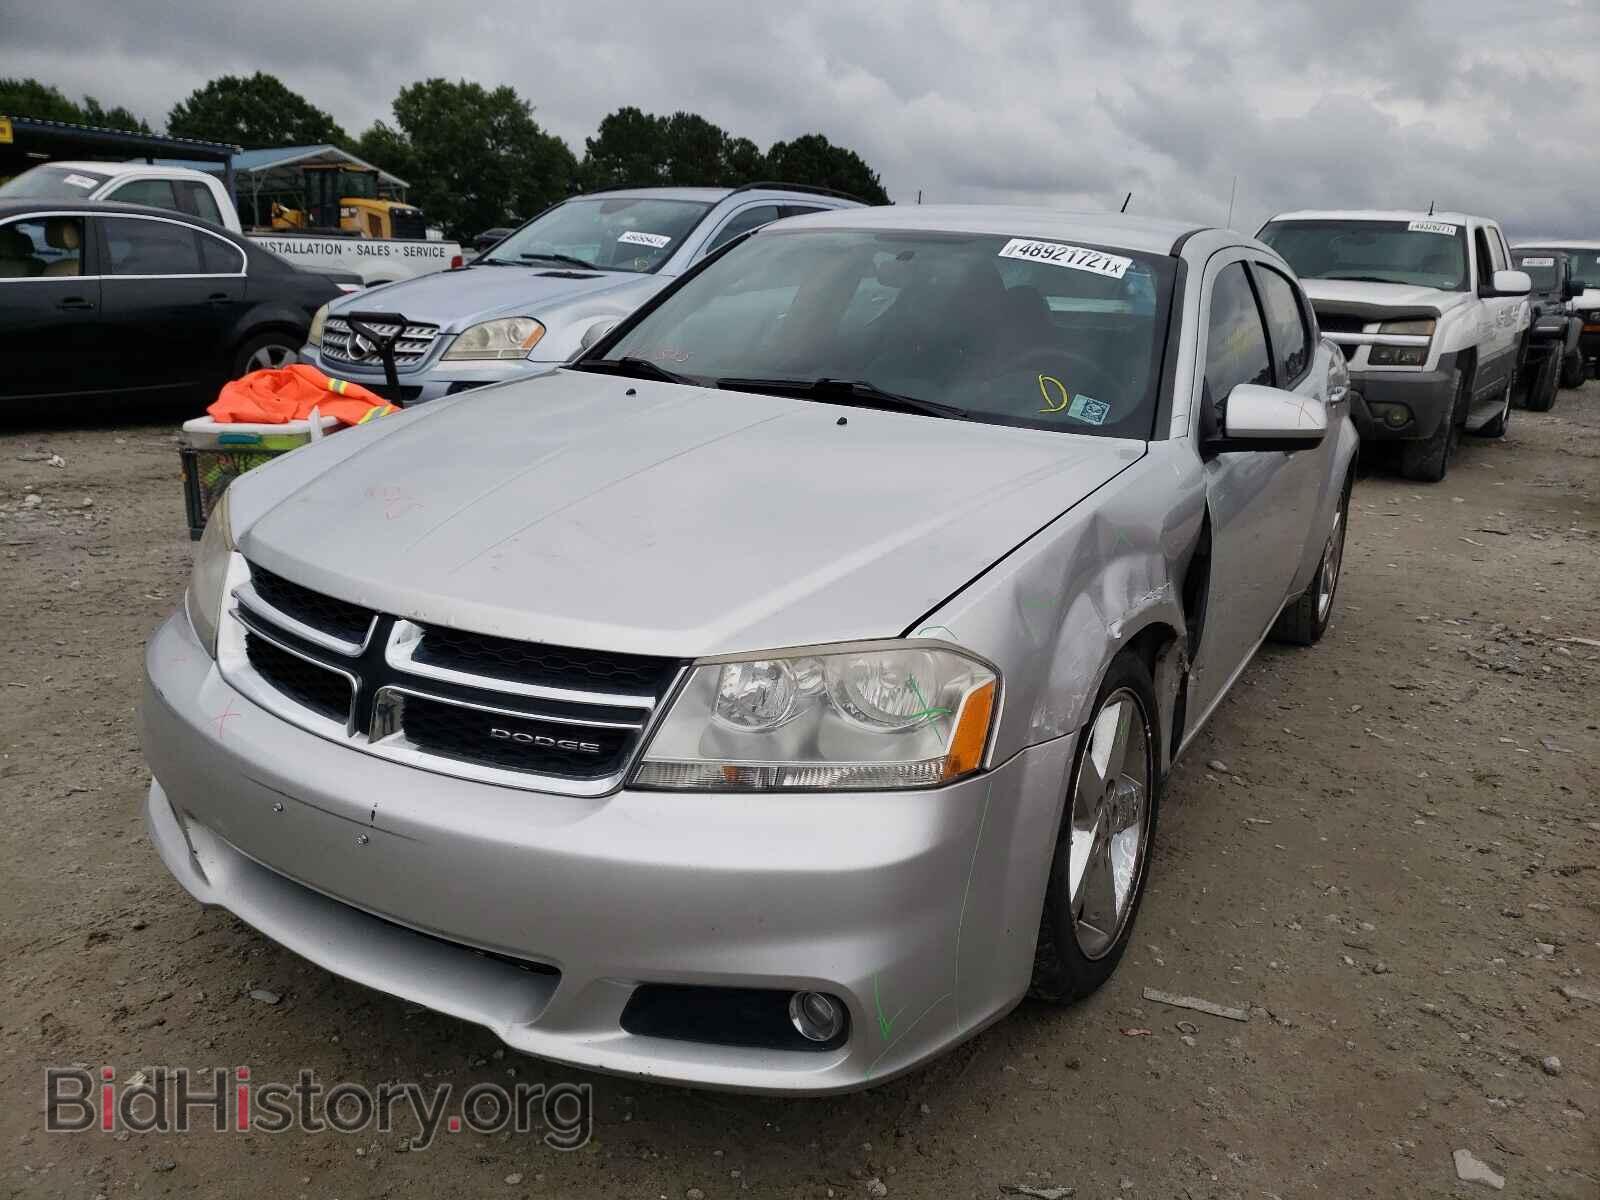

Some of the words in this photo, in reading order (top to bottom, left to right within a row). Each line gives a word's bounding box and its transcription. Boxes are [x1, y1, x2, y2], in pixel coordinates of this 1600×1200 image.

[356, 244, 391, 257] SALES
[402, 245, 446, 258] SERVICE
[490, 727, 600, 753] DODGE
